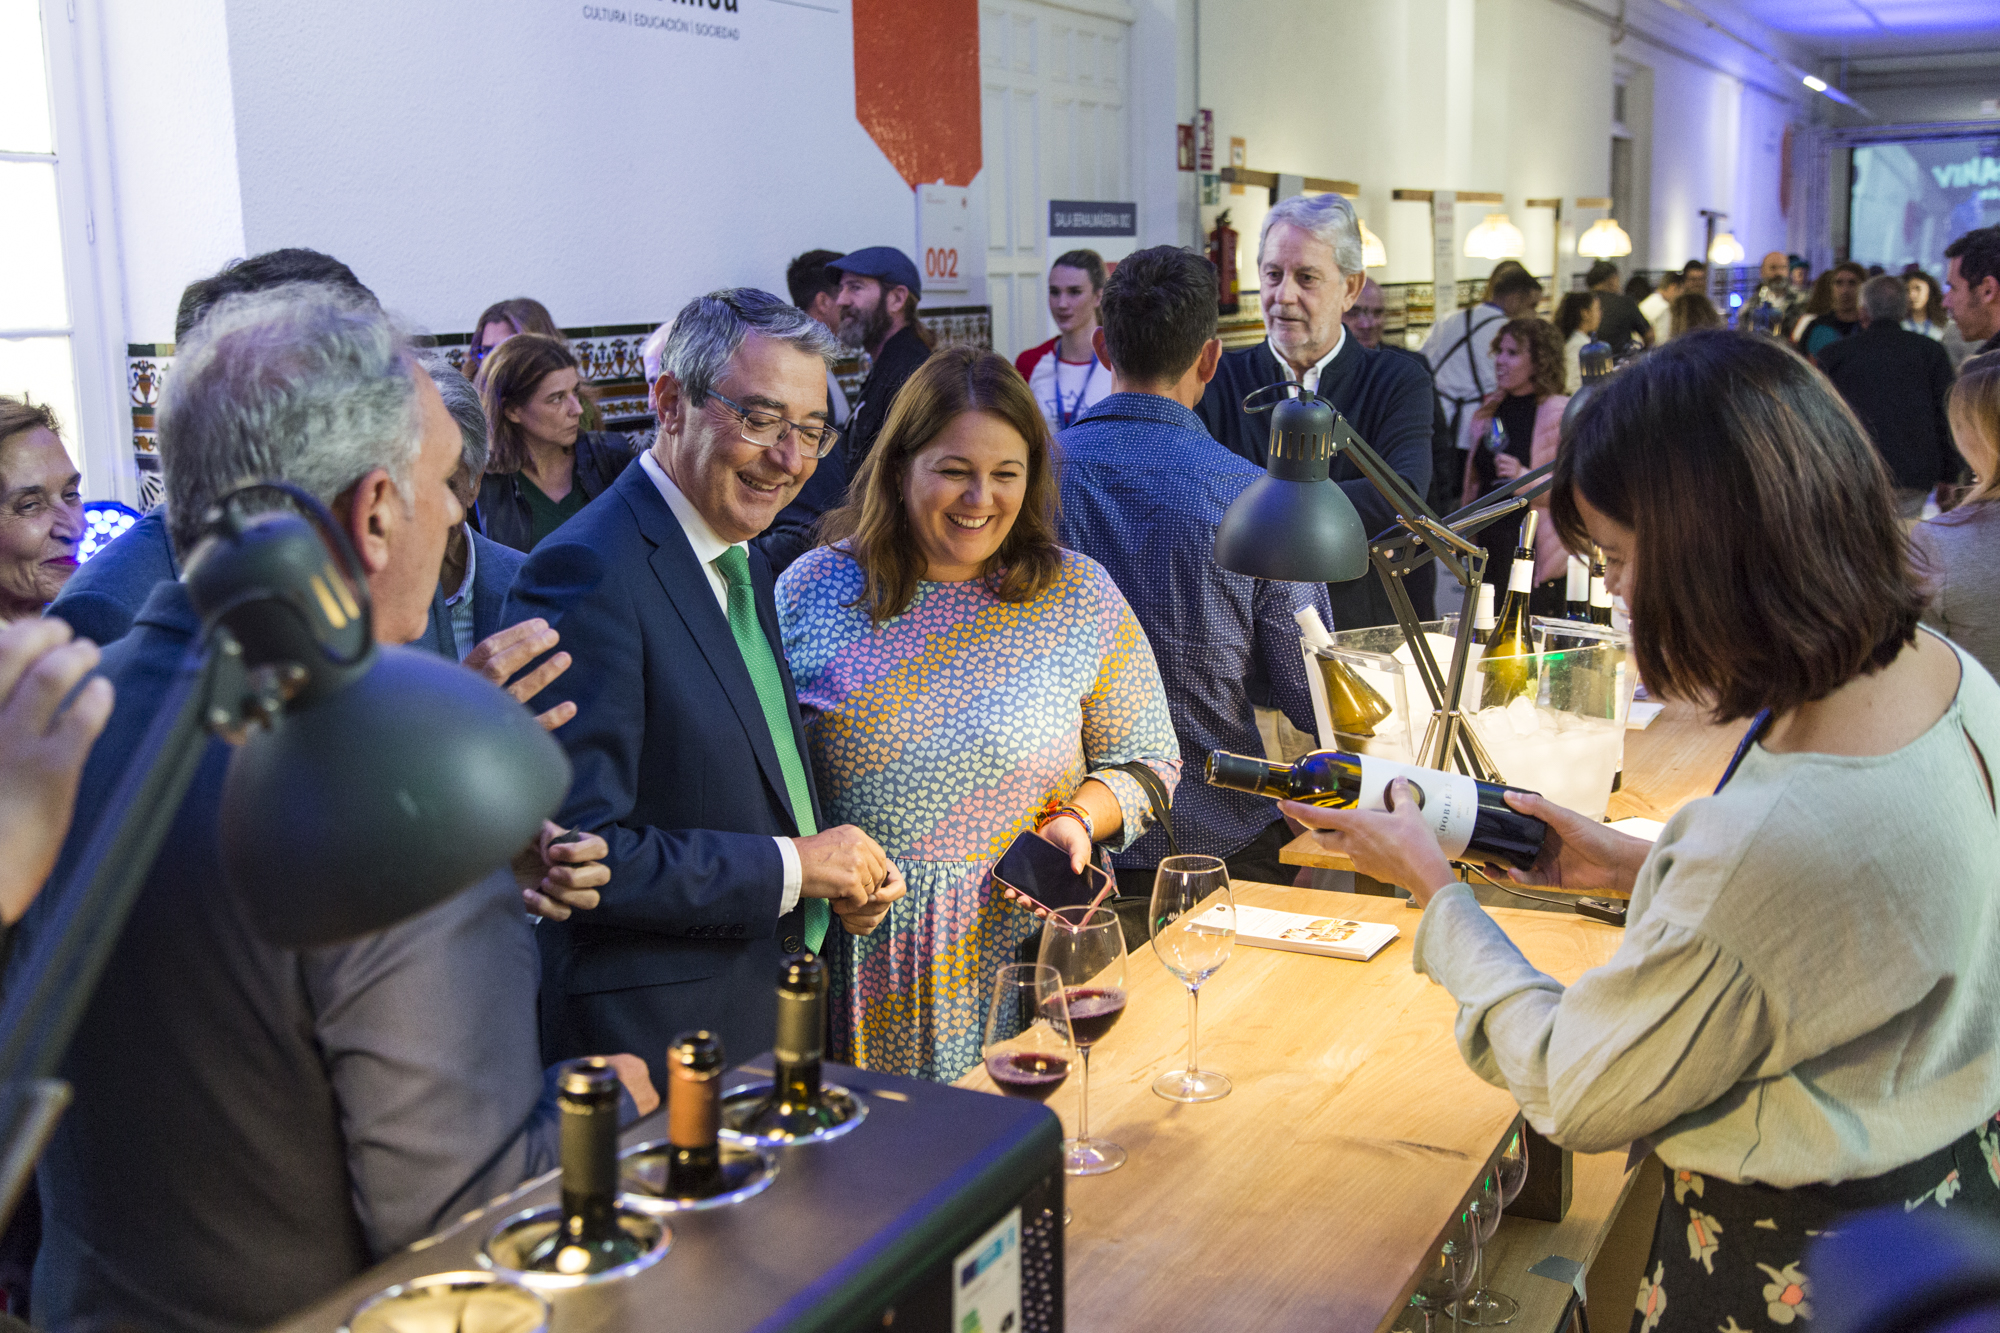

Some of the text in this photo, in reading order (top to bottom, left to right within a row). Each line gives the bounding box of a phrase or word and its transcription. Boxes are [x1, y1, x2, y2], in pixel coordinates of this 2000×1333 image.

[582, 5, 627, 24] CULTURA
[695, 22, 741, 41] SOCIEDAD
[925, 247, 959, 278] 002
[1439, 793, 1452, 832] DOBLE
